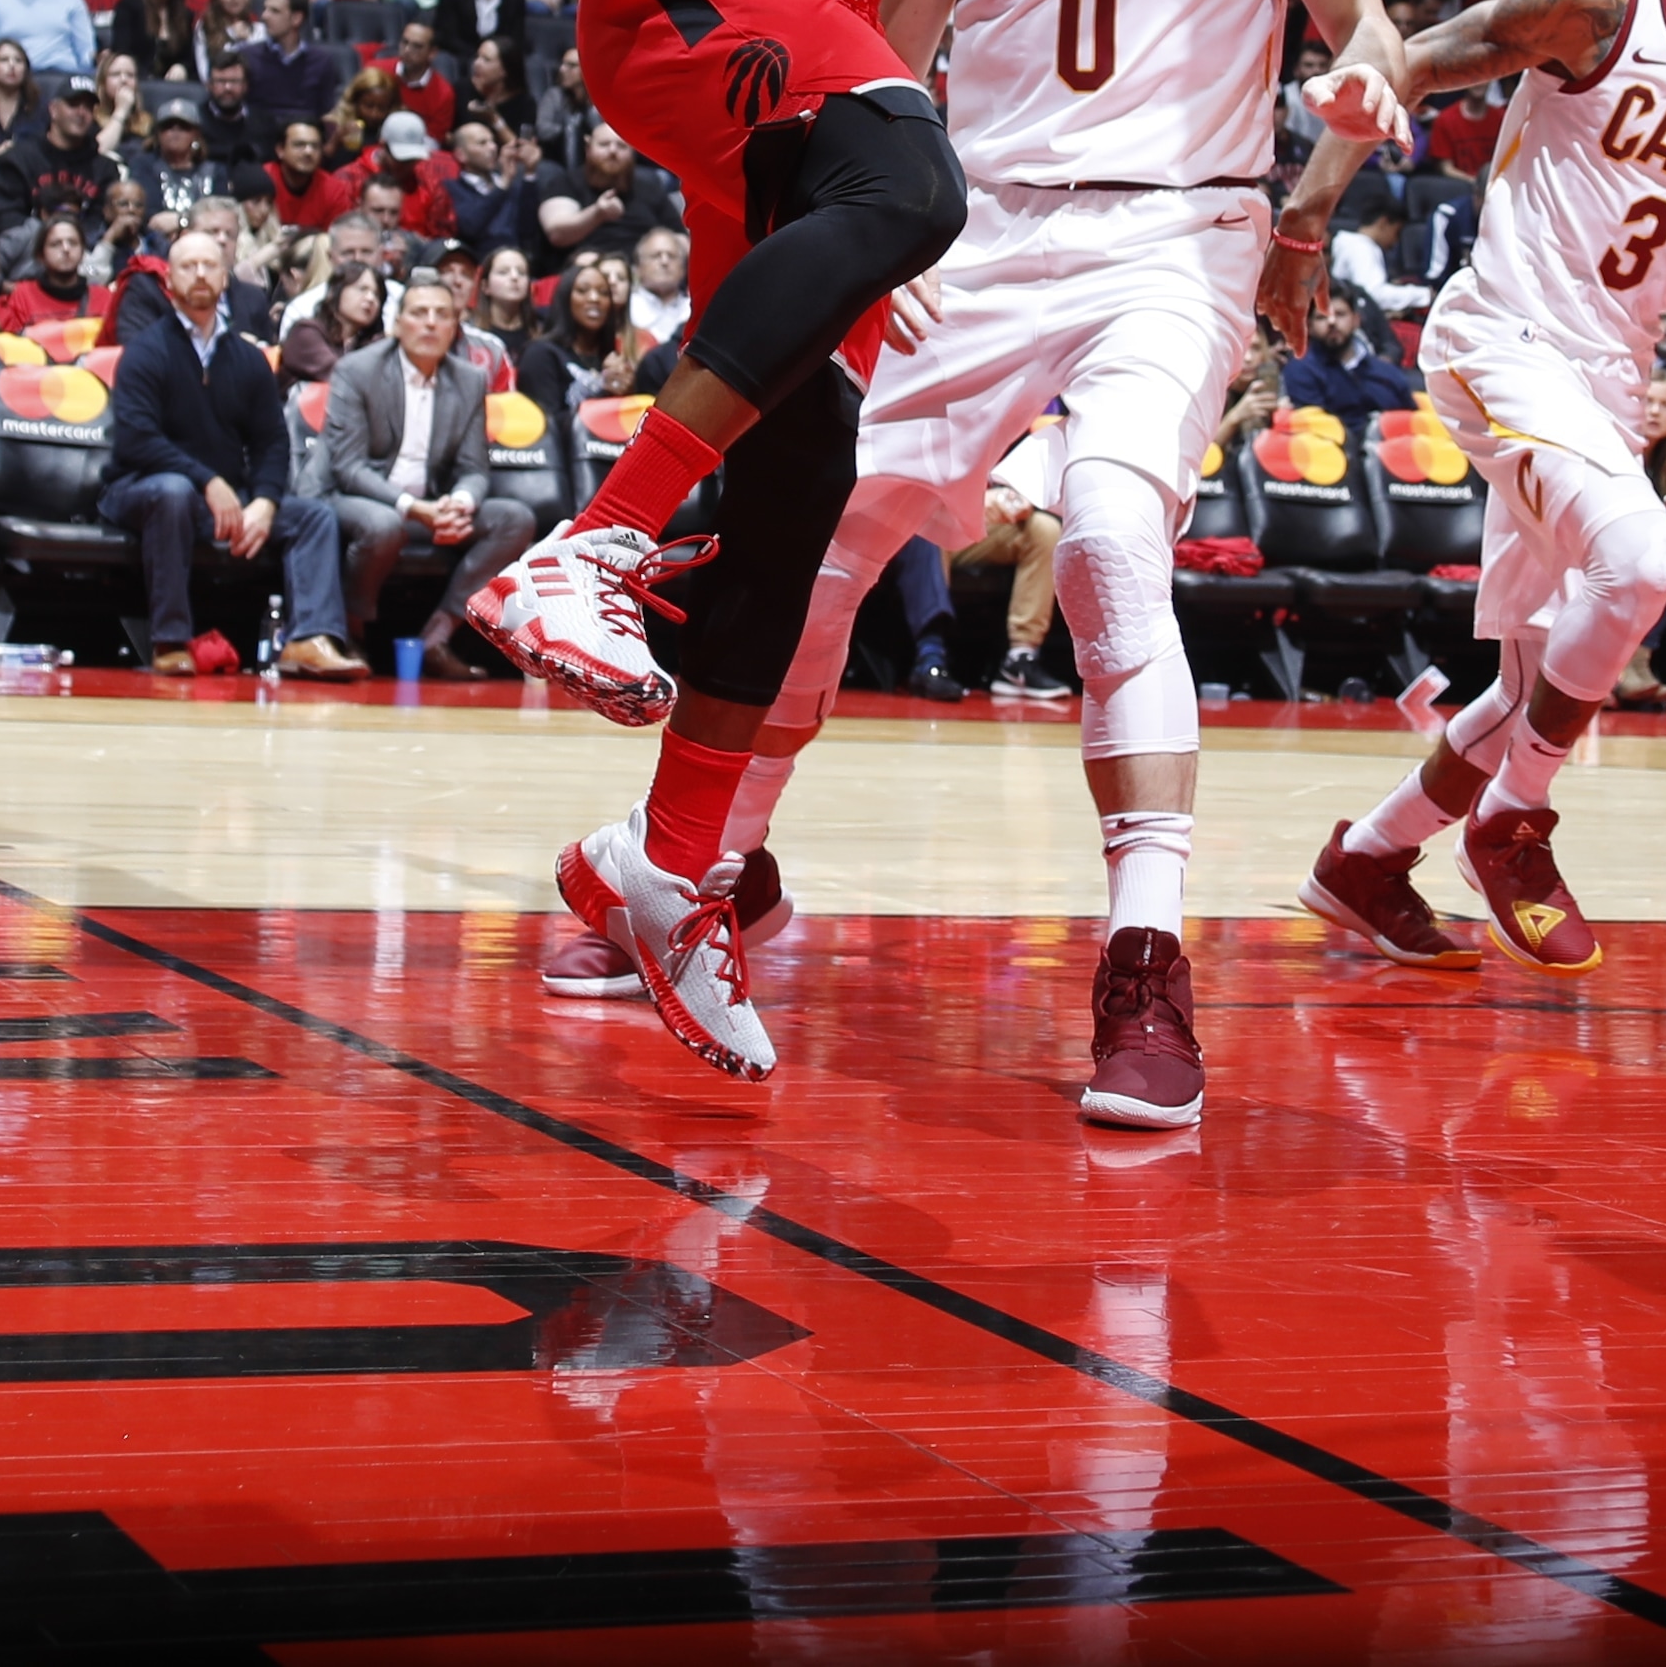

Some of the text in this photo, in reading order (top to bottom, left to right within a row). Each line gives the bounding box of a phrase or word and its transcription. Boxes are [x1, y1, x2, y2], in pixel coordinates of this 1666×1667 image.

[2, 418, 104, 442] mastercard
[1263, 480, 1352, 502] mastercard
[1388, 482, 1473, 501] mastercard
